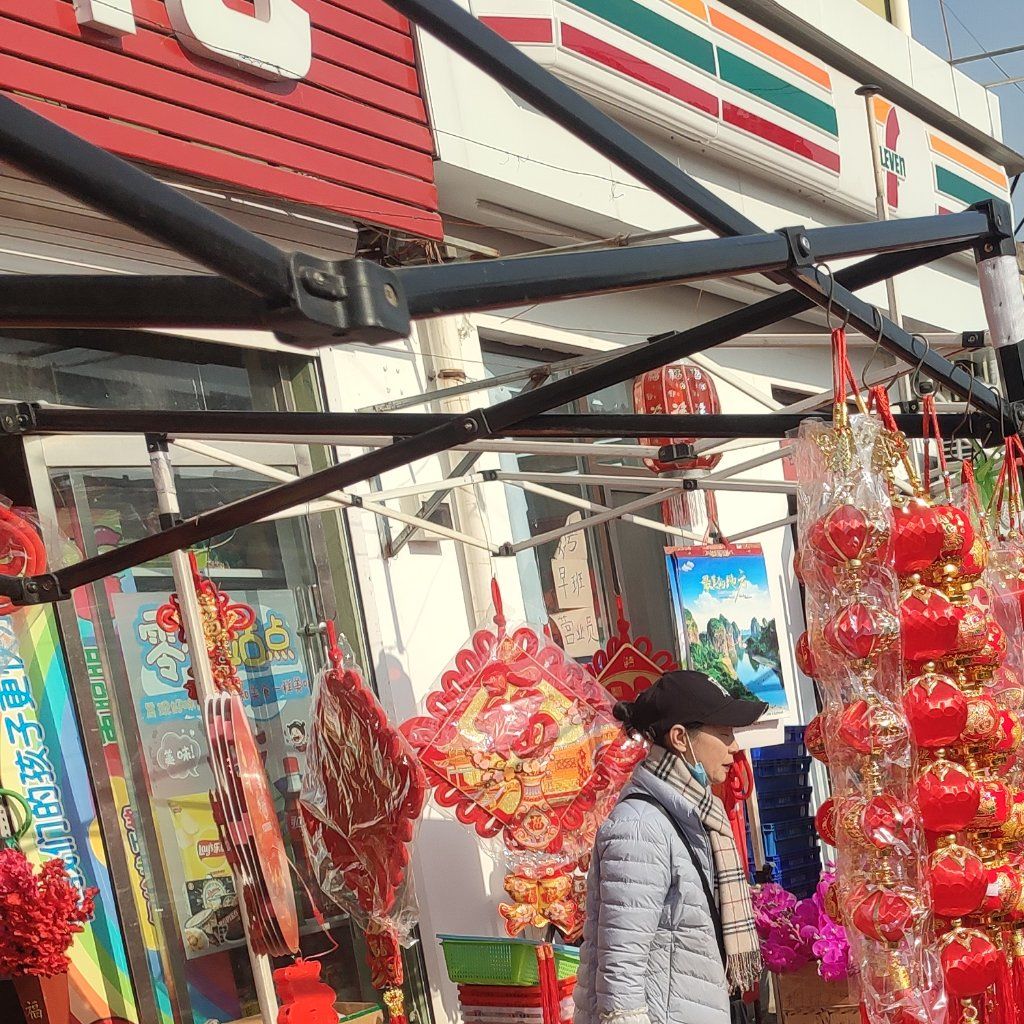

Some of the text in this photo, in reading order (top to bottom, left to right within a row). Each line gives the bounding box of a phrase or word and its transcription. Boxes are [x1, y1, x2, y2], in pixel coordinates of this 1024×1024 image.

[879, 145, 906, 179] LEVEn
[558, 566, 586, 599] 早班
[138, 609, 297, 682] 零站点
[558, 615, 599, 645] 营业员
[25, 1000, 43, 1020] 福
